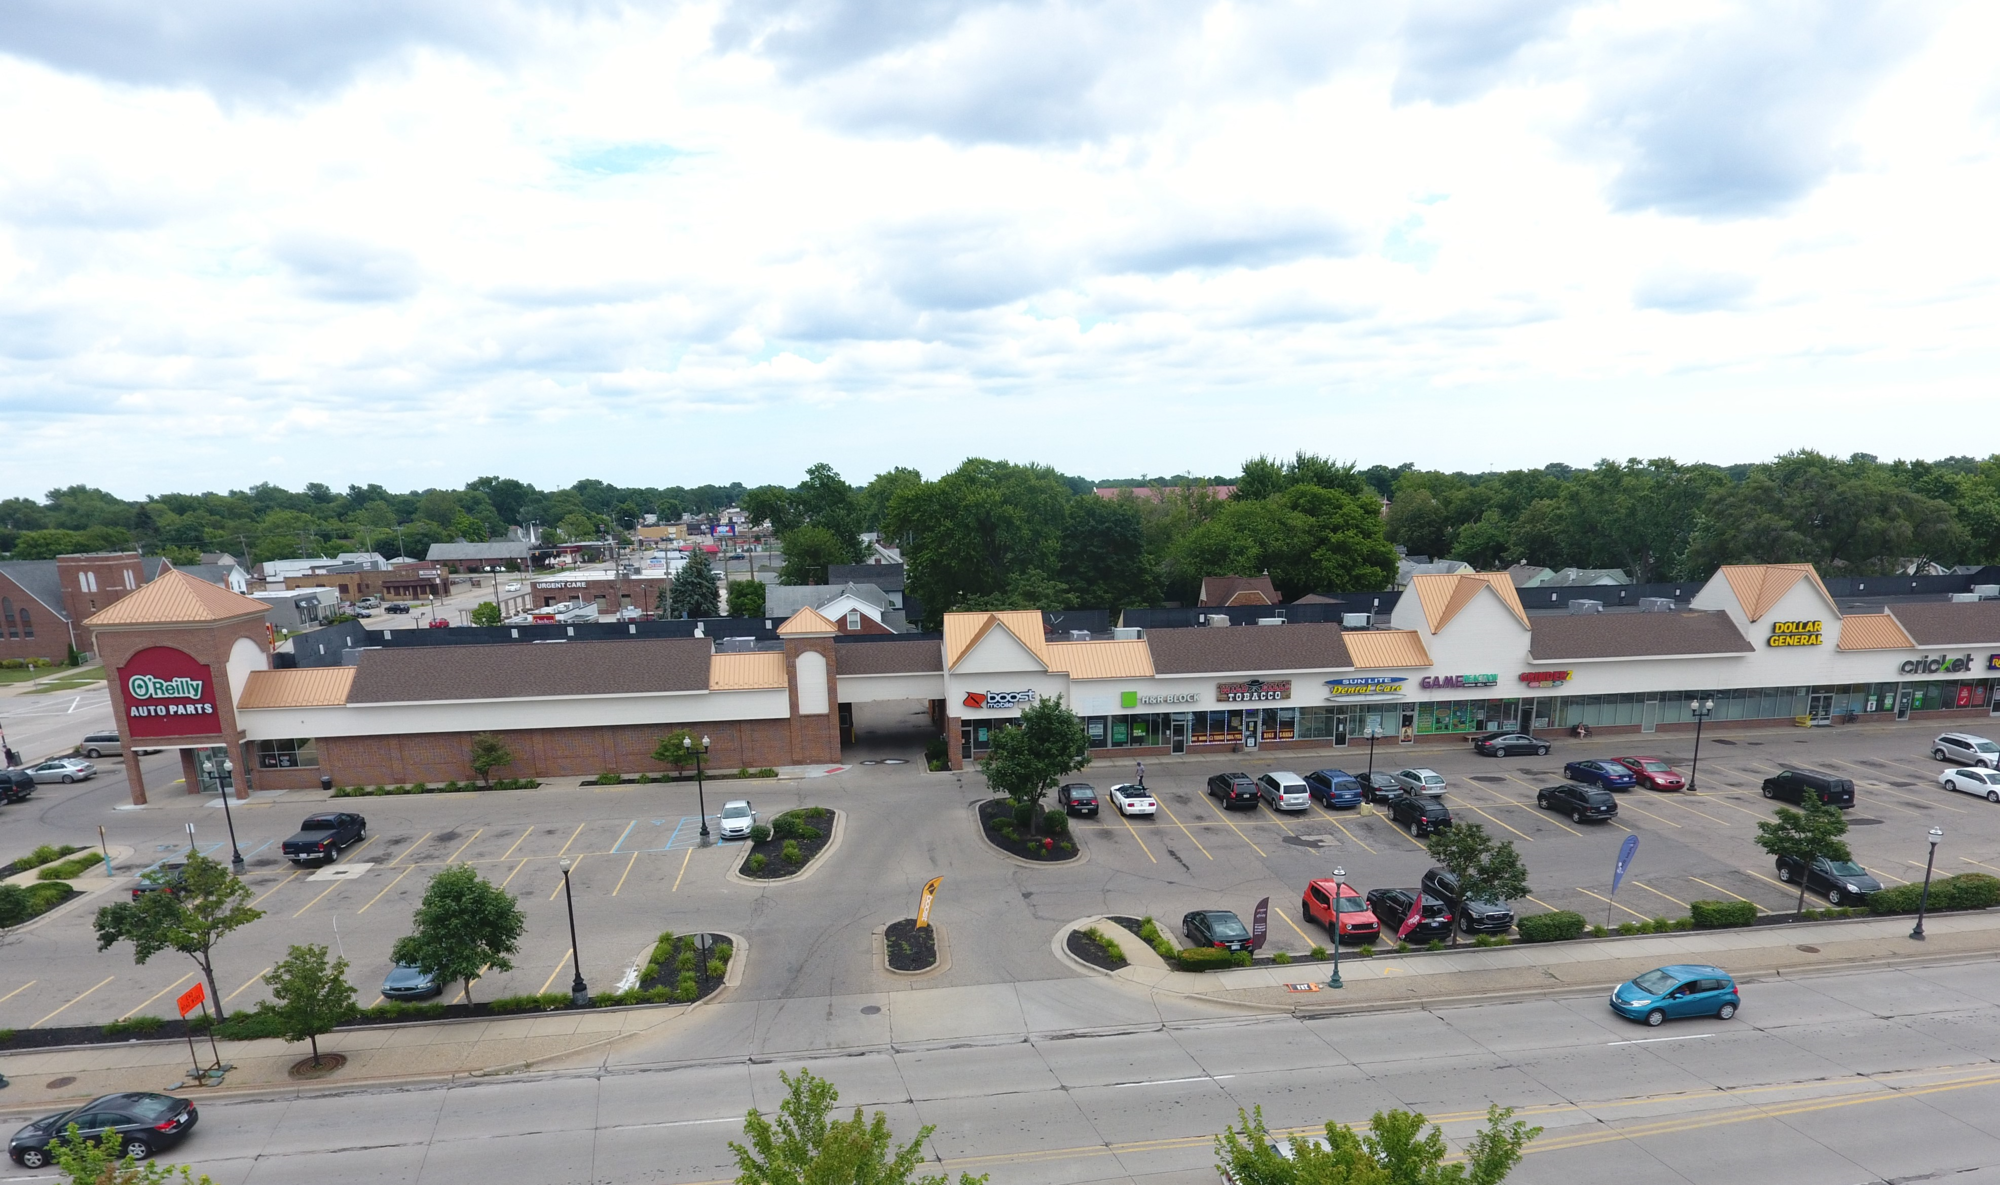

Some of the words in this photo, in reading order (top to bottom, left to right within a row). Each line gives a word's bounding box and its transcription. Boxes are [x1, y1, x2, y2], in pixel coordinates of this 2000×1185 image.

[1773, 620, 1823, 633] DOLLAR
[1768, 634, 1823, 647] GENERAL
[1900, 653, 1974, 674] cricket
[1420, 674, 1464, 689] GAME
[1463, 673, 1498, 682] REACTION
[1519, 670, 1573, 682] GRINDERZ
[129, 675, 203, 699] O'Reilly
[1220, 684, 1248, 693] WILD
[1331, 684, 1372, 695] Dental
[1375, 683, 1403, 693] Care
[986, 689, 1035, 703] boost
[1141, 695, 1164, 704] H&R
[1167, 693, 1201, 703] BLOCK
[1228, 691, 1281, 701] TOBACCO
[130, 705, 166, 717] AUTO
[169, 703, 213, 715] PARTS
[987, 701, 1014, 709] mobile
[922, 895, 933, 921] boost
